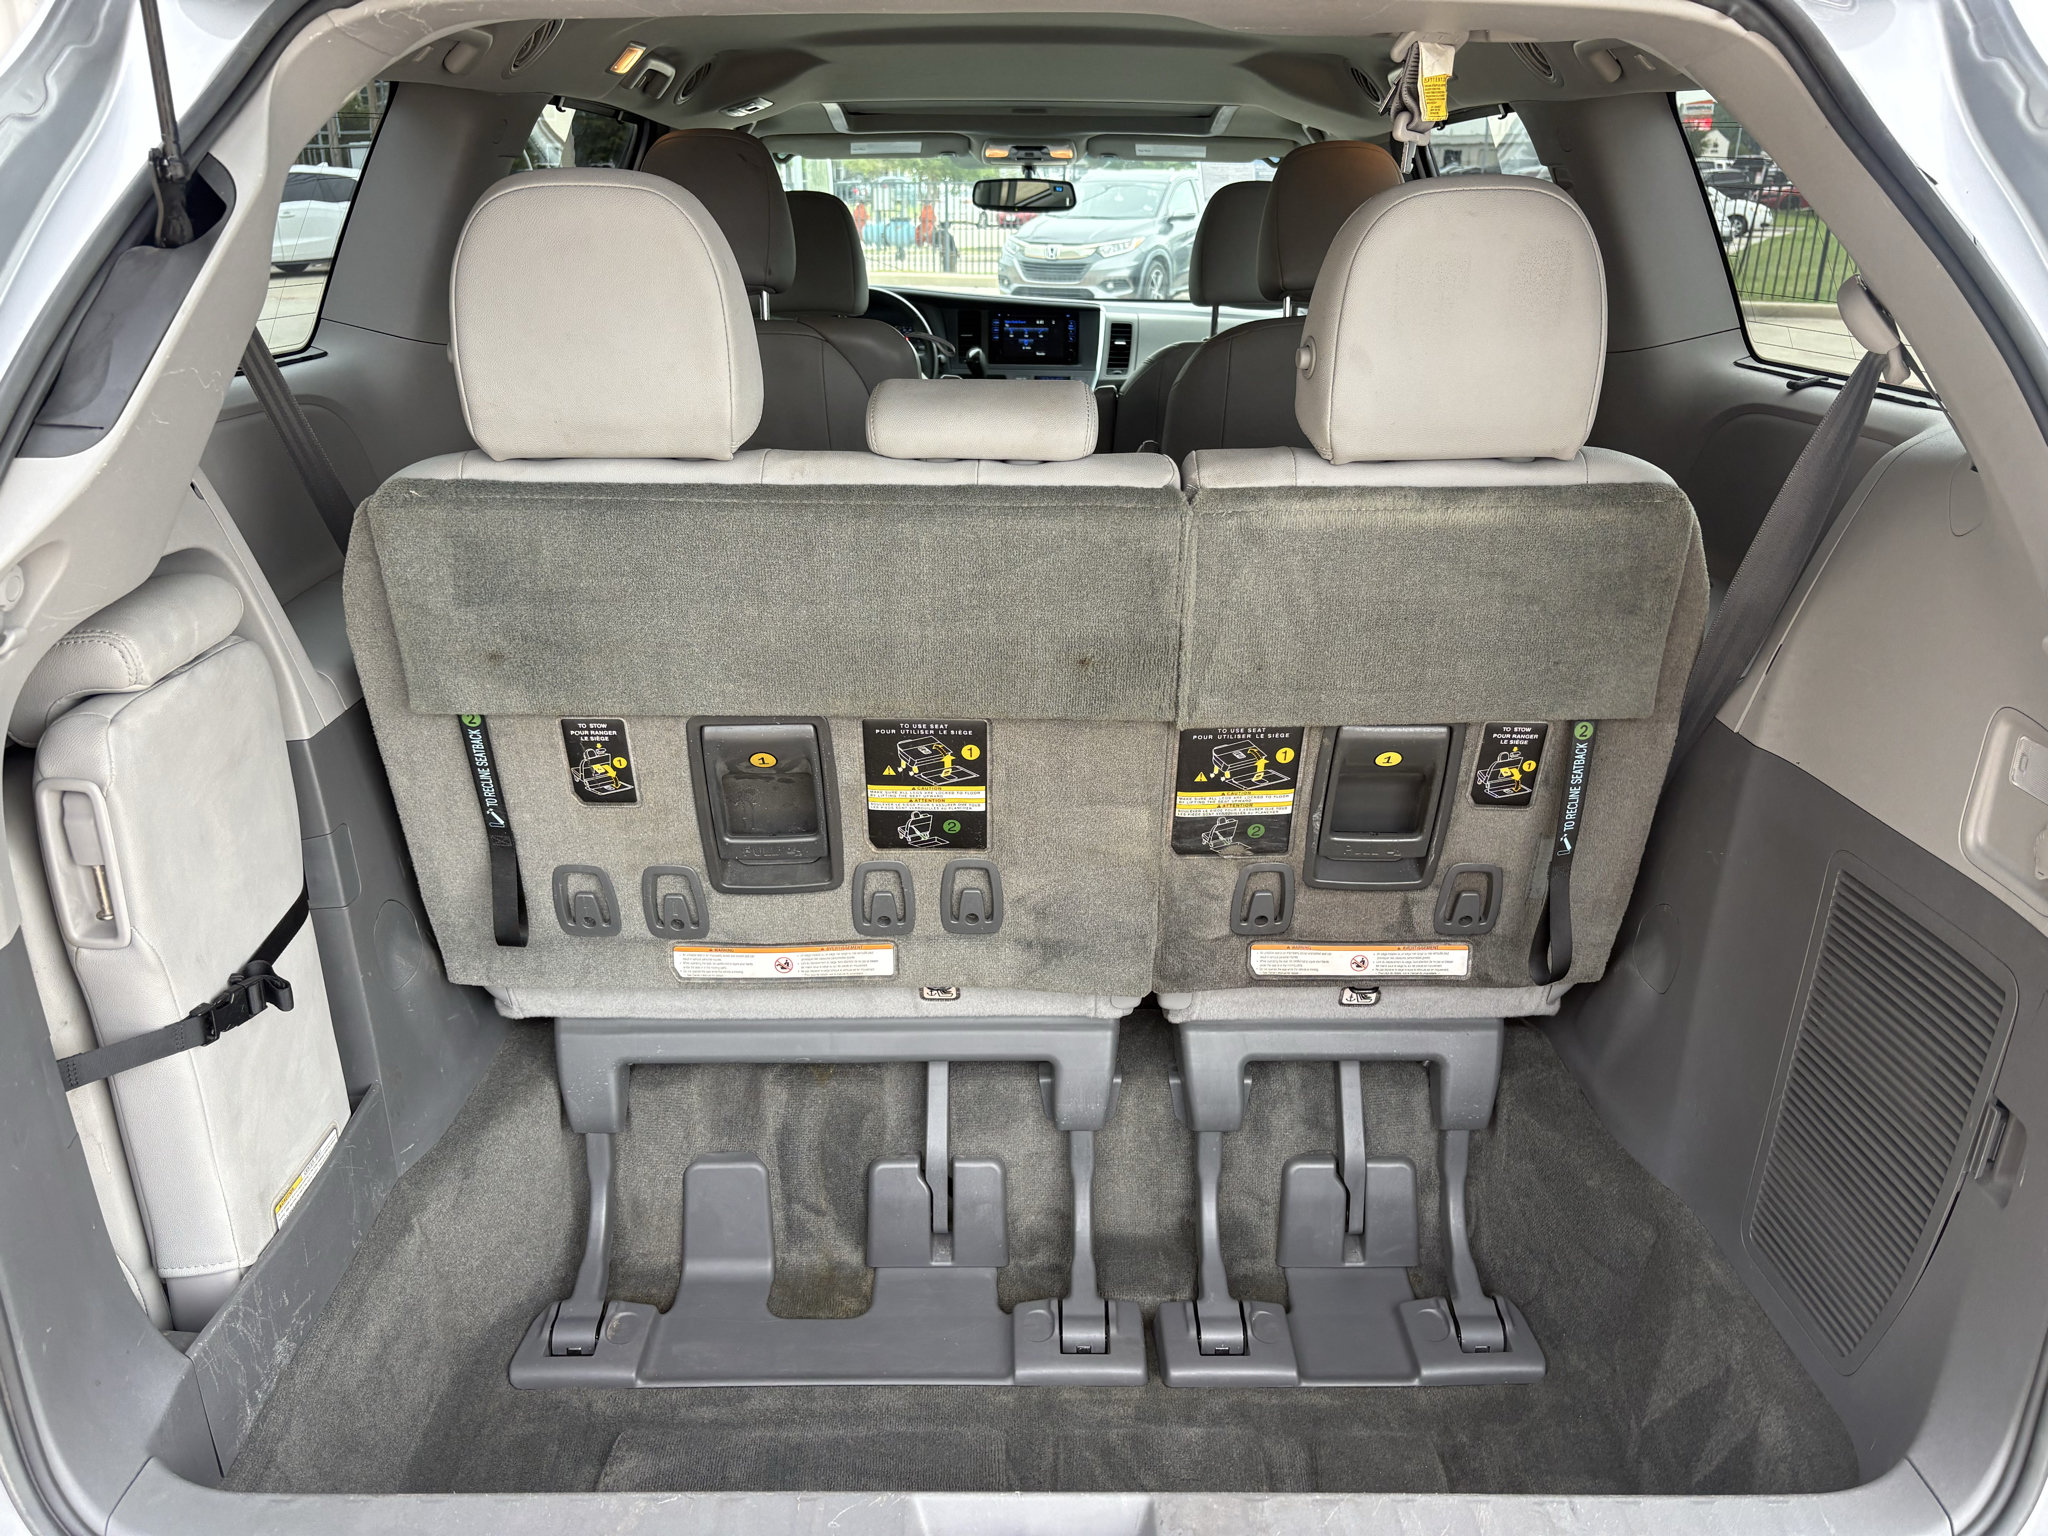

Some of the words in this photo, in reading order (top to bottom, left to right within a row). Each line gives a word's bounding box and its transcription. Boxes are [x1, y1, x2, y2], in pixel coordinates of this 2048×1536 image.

[1580, 725, 1588, 737] 2
[468, 729, 488, 766] SEATBACK
[1571, 743, 1587, 785] SEATBACK
[477, 766, 496, 796] RECLINE
[486, 796, 498, 807] TO
[1566, 786, 1580, 819] RECLINE
[947, 822, 957, 832] 2
[1252, 826, 1260, 836] 2
[1564, 820, 1574, 831] TO
